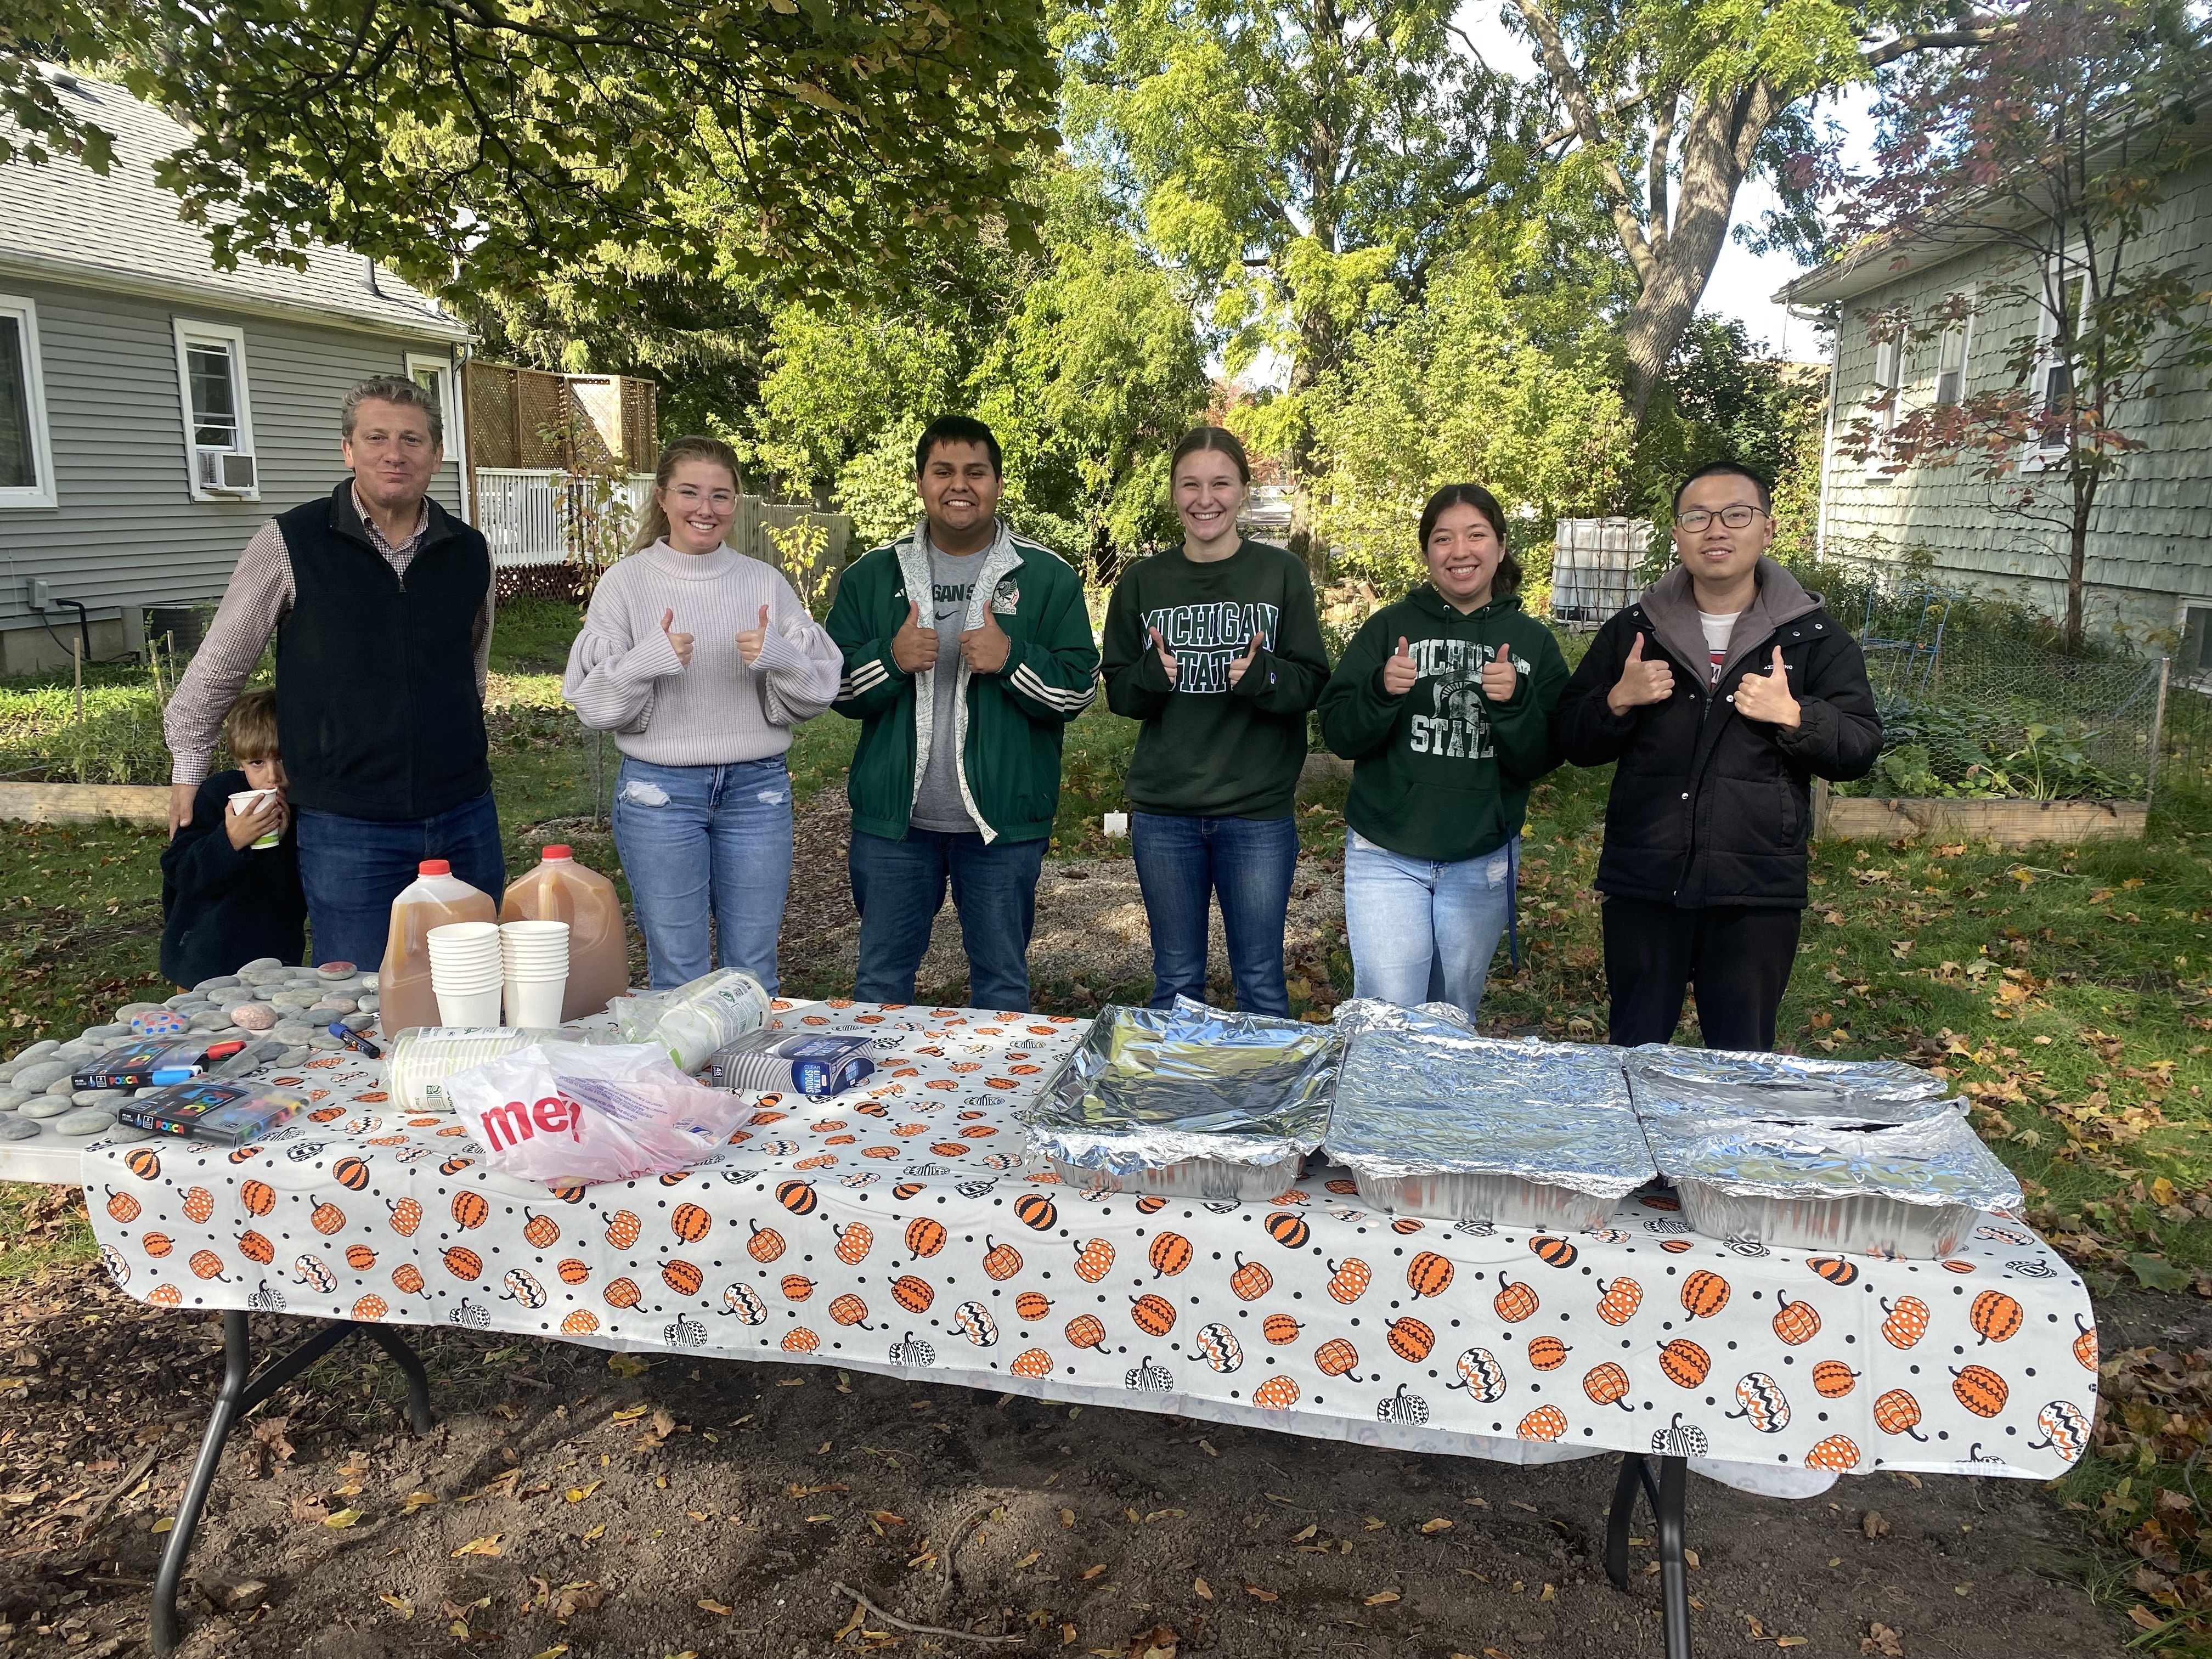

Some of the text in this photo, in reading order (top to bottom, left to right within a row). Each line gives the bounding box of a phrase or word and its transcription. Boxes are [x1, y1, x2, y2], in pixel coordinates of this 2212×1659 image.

[1170, 646, 1245, 693] TAT
[715, 1067, 722, 1077] 48
[109, 1076, 139, 1085] POSCA
[804, 1069, 814, 1094] SPOONS
[156, 1120, 184, 1134] POSCA
